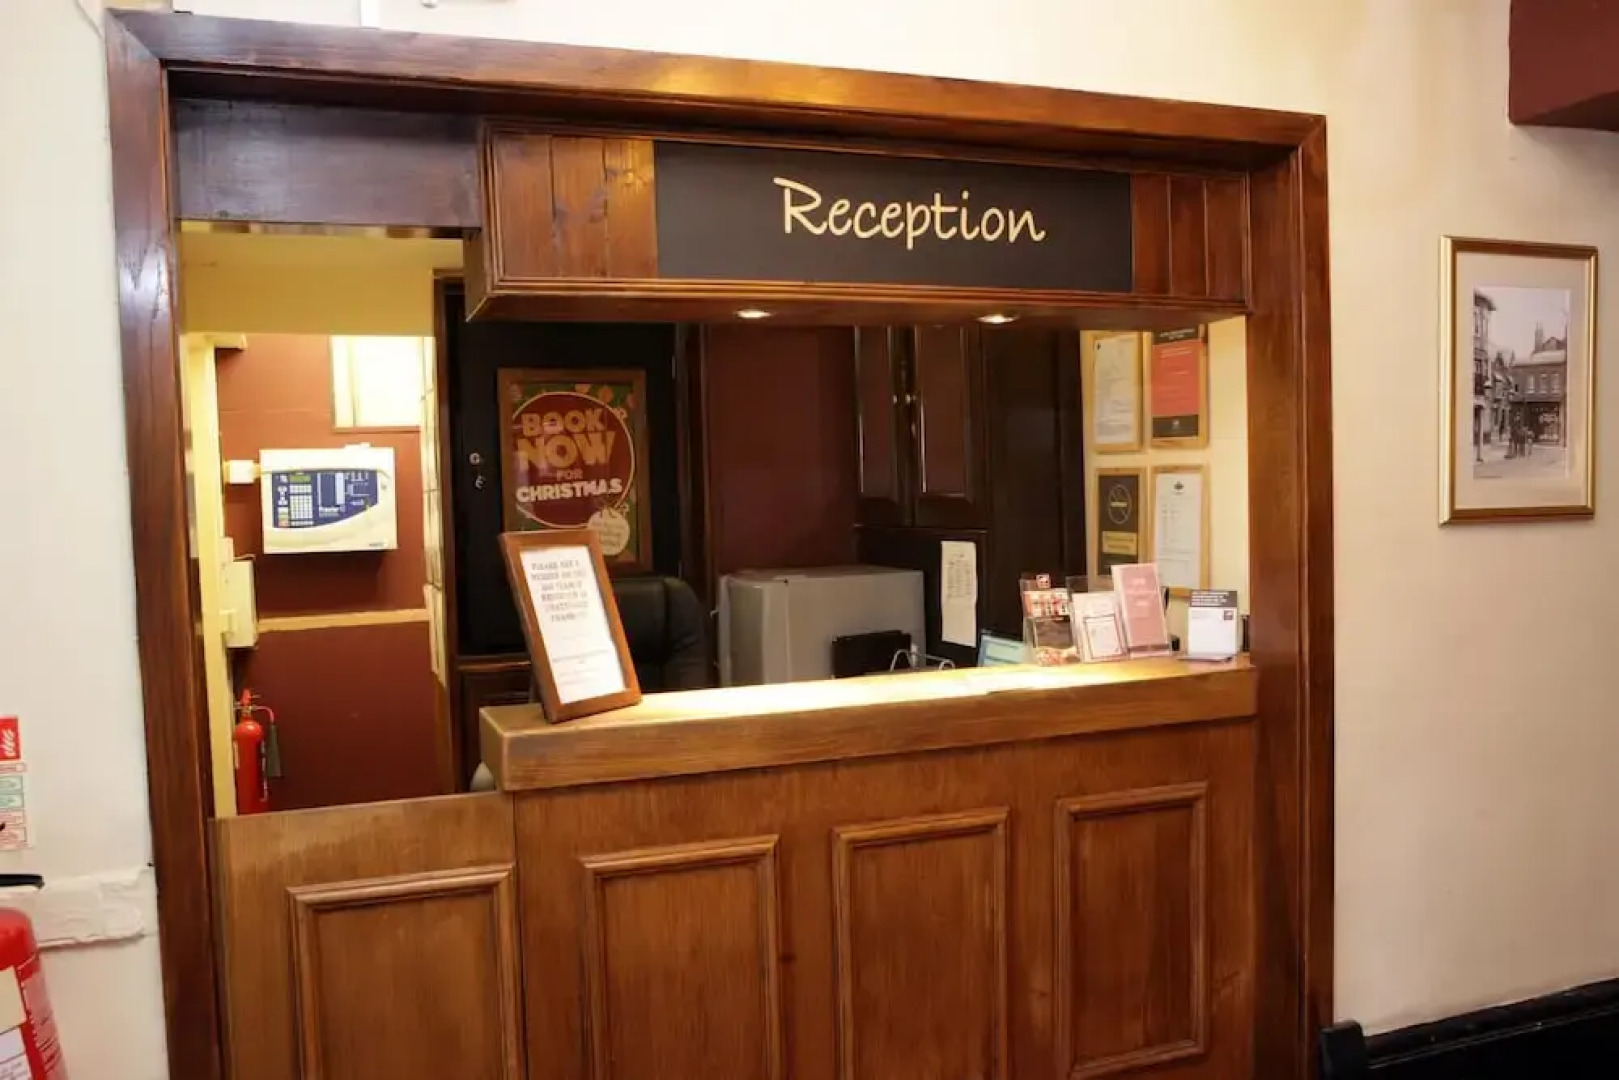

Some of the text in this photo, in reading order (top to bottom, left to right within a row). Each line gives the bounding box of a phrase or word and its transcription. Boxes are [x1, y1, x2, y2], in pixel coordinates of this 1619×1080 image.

[773, 177, 1046, 250] Reception
[521, 408, 606, 437] BOOK
[517, 431, 616, 471] NOW
[516, 478, 622, 502] CHRISTMAS
